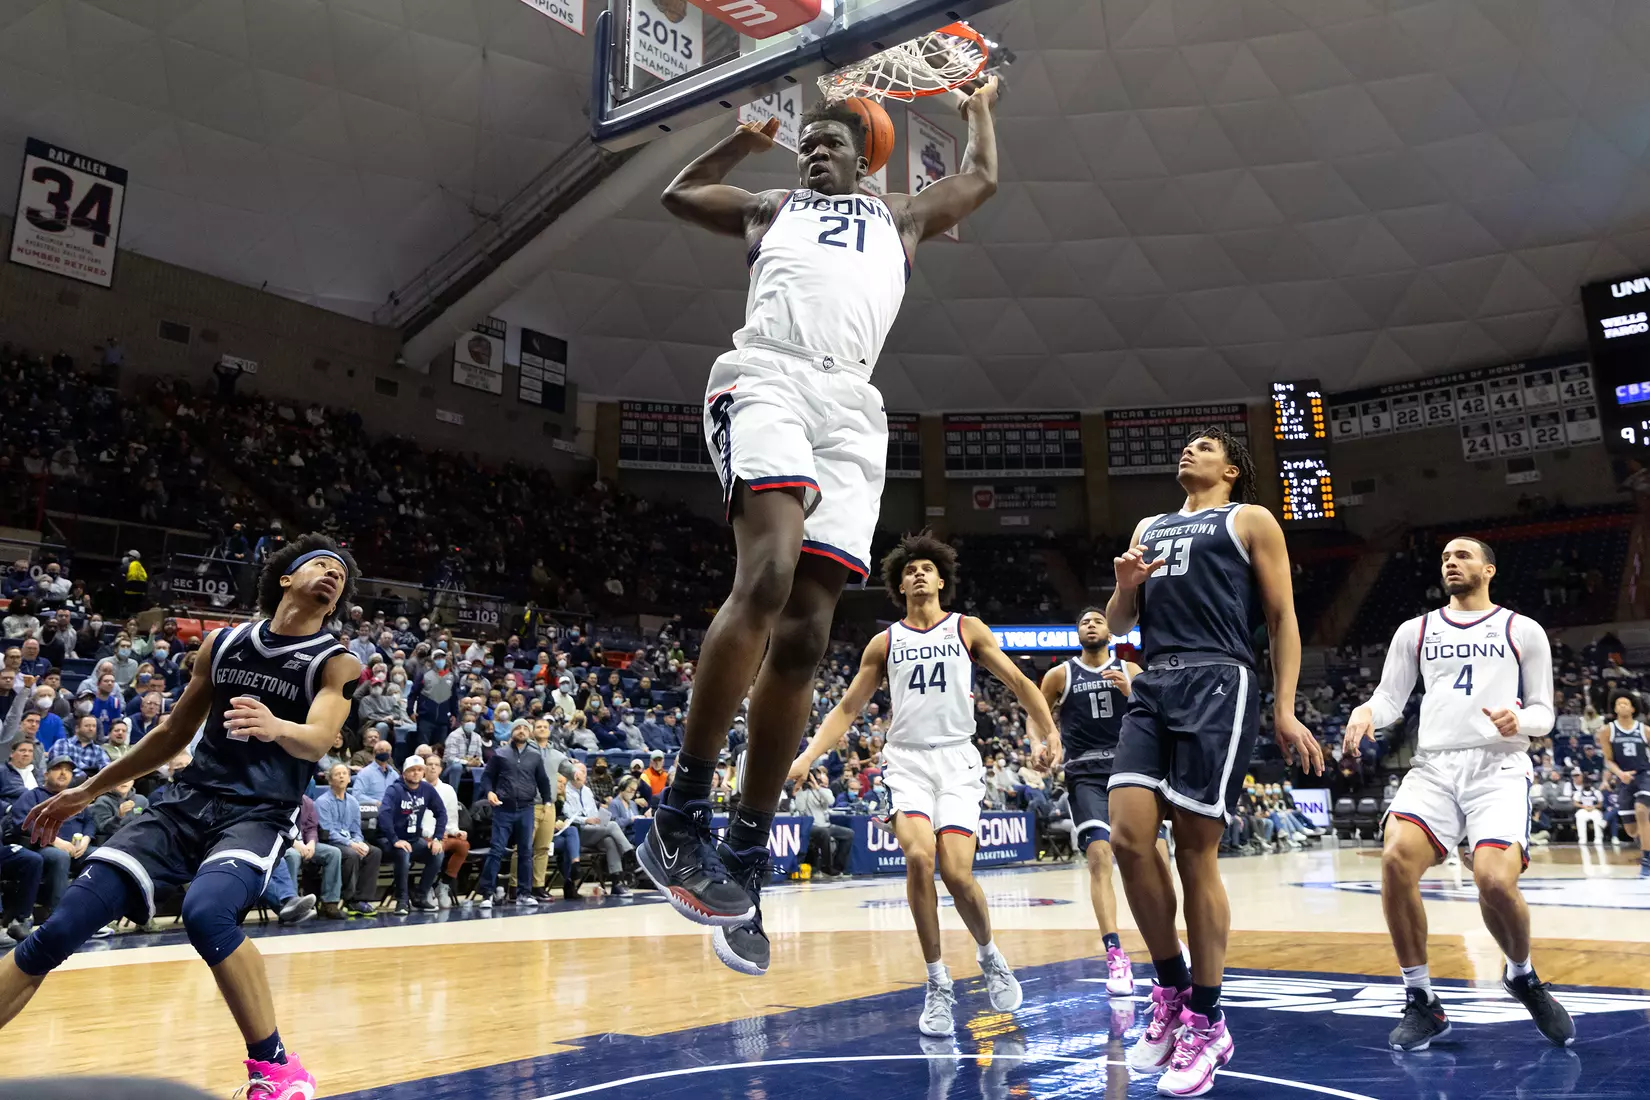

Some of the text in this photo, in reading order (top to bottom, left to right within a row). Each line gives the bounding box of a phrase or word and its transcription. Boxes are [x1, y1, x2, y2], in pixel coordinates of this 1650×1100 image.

[637, 10, 693, 60] 2013
[48, 148, 107, 176] RAY ALLEN
[26, 166, 114, 248] 34
[789, 198, 891, 226] UCONN
[818, 216, 866, 253] 21
[64, 259, 107, 277] RETIRED
[1600, 312, 1648, 328] WELLS
[1603, 323, 1649, 339] FARGO
[1488, 364, 1526, 375] HONOR
[1565, 381, 1589, 397] 42
[622, 402, 642, 411] BIG
[1462, 399, 1485, 413] 42
[1495, 393, 1519, 408] 44
[1112, 405, 1239, 420] NCAA CHAMPIONSHIP
[1397, 410, 1419, 425] 22
[1428, 404, 1451, 419] 25
[1340, 420, 1352, 434] C
[1372, 416, 1381, 429] 9
[1503, 432, 1523, 448] 13
[1536, 427, 1560, 443] 22
[1467, 438, 1490, 453] 24
[1143, 523, 1218, 543] GEORGETOWN
[1150, 537, 1194, 578] 23
[173, 578, 229, 596] SEC 109
[458, 610, 499, 623] SEC 109
[892, 644, 960, 664] UCONN
[1425, 643, 1505, 661] UCONN
[1168, 654, 1180, 667] G
[216, 667, 300, 702] GEORGETOWN
[908, 661, 947, 695] 44
[1453, 664, 1474, 696] 4
[1088, 690, 1114, 719] 13
